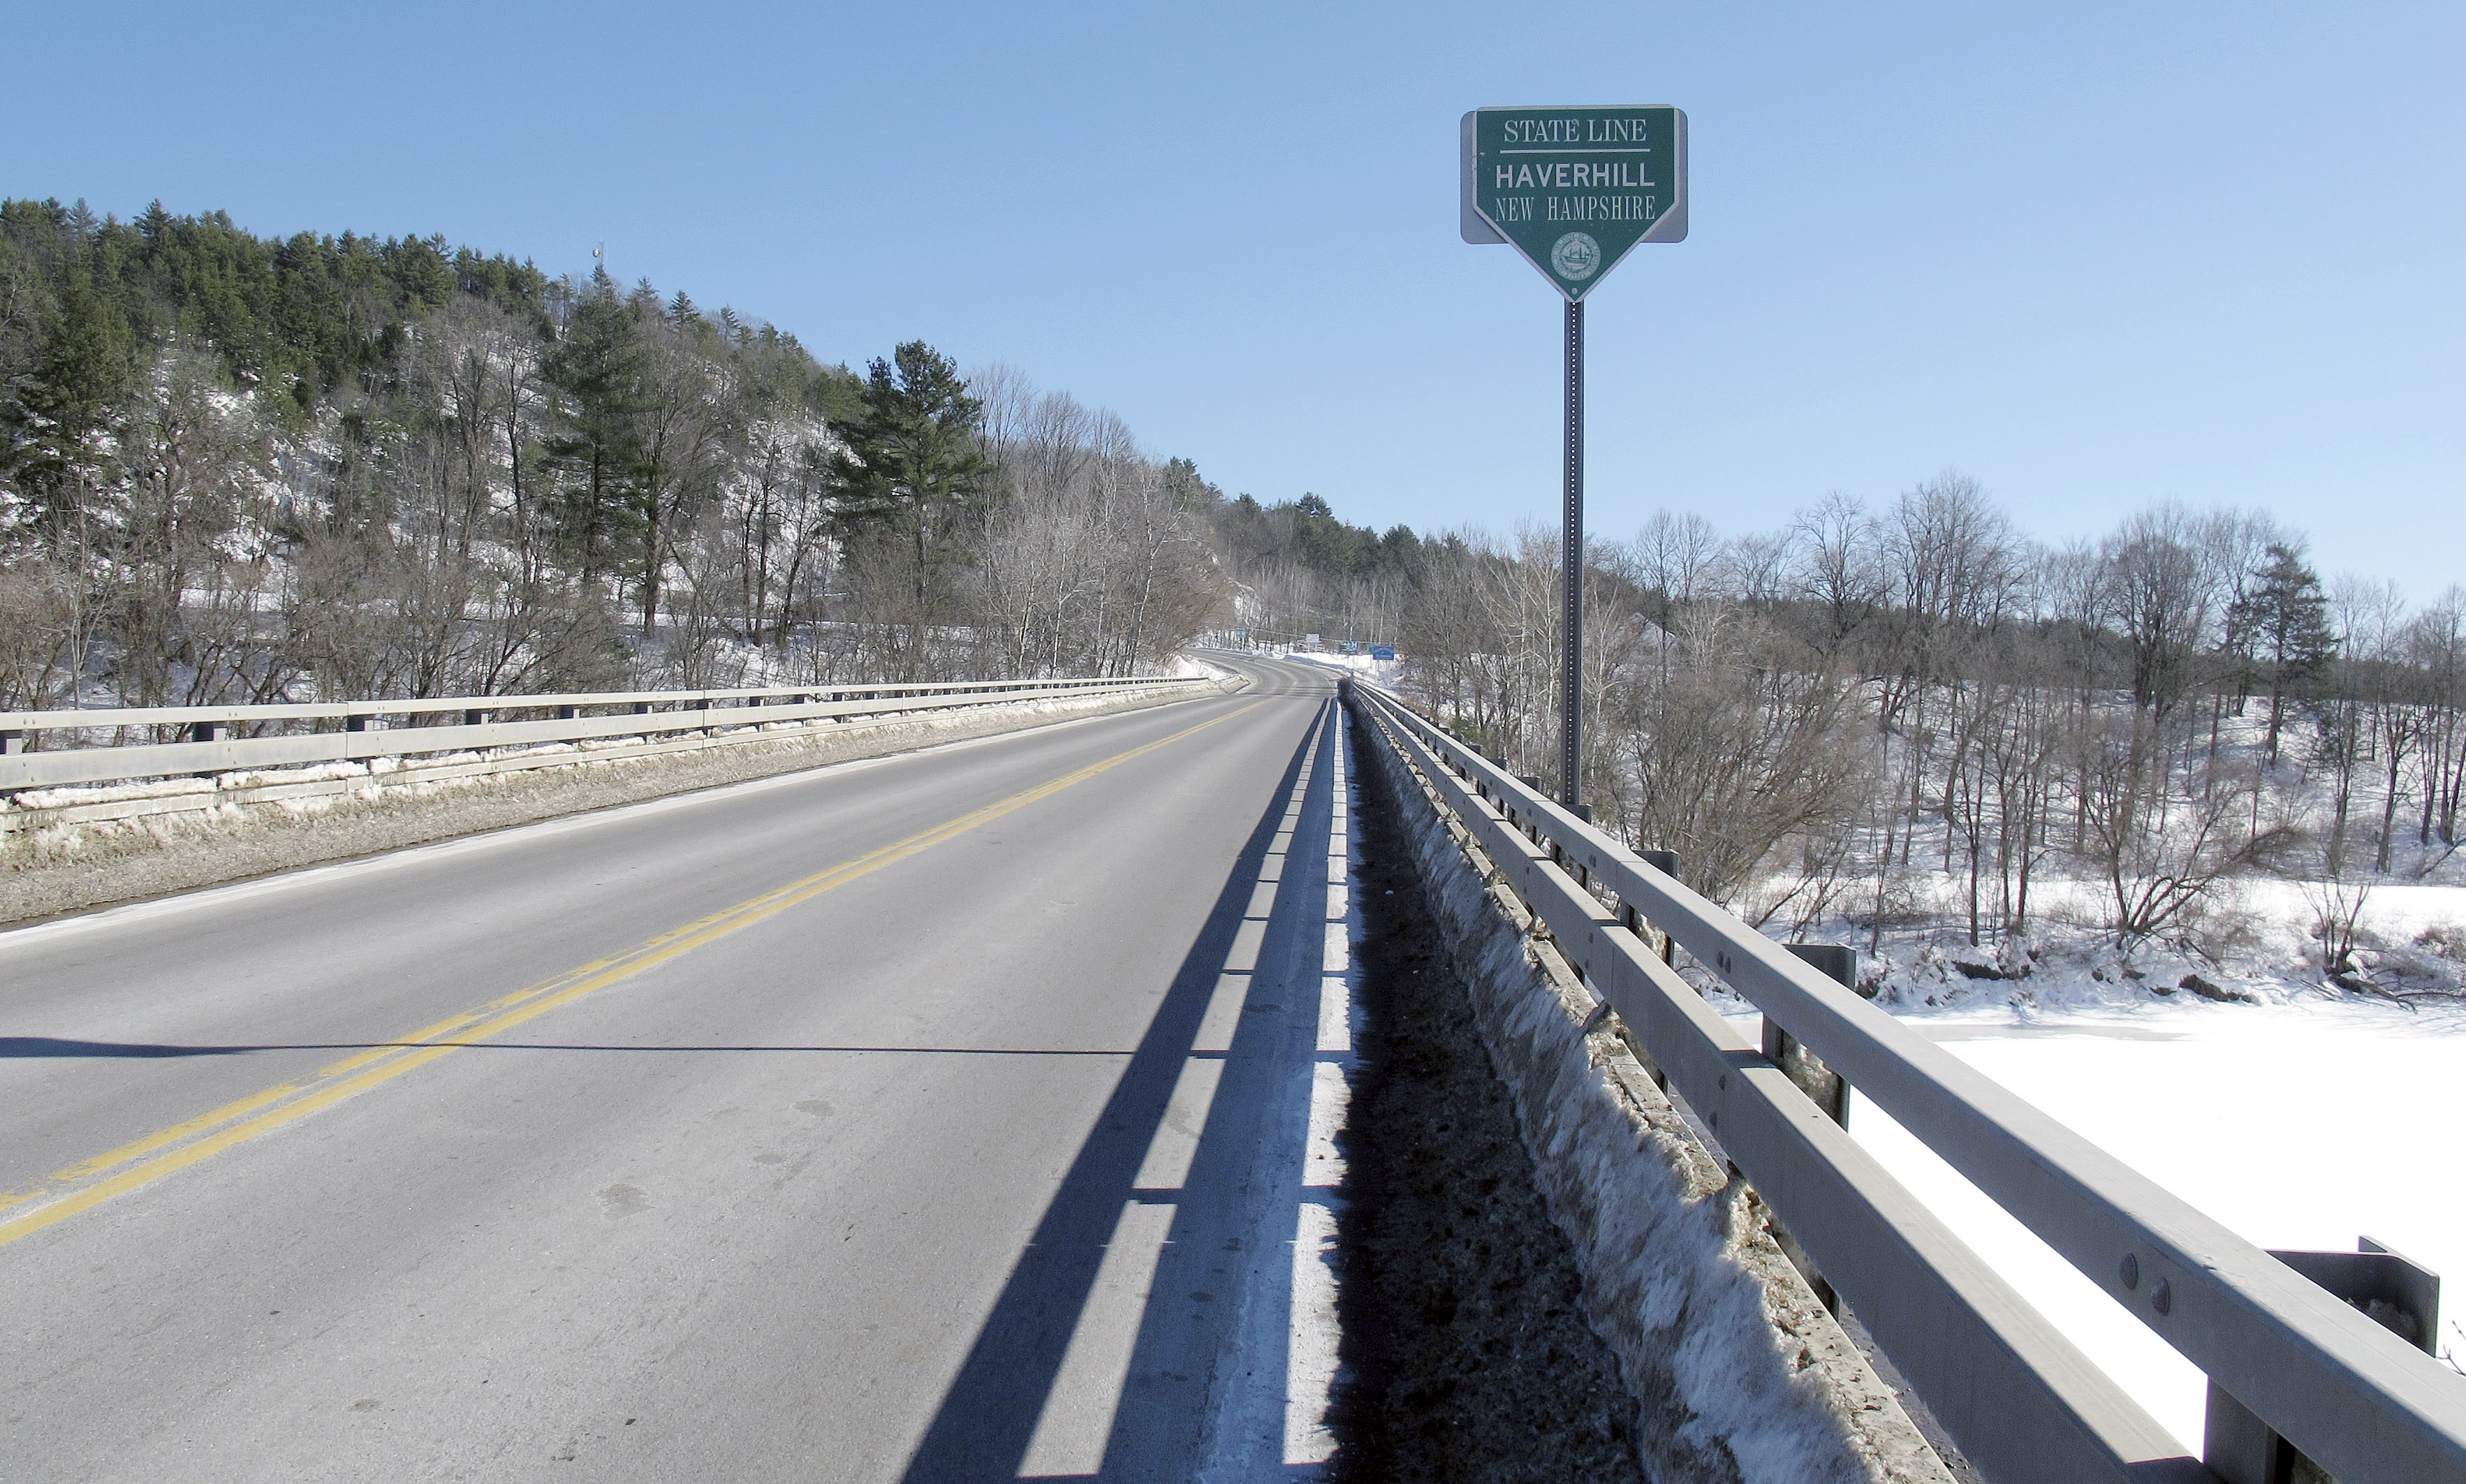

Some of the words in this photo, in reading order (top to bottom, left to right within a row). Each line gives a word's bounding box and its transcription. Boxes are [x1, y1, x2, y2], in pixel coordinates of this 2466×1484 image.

[1504, 118, 1580, 142] STATE
[1589, 118, 1646, 142] LINE
[1496, 162, 1655, 189] HAVERHILL
[1495, 196, 1534, 221] NEW
[1548, 195, 1656, 221] HAMPSHIRE
